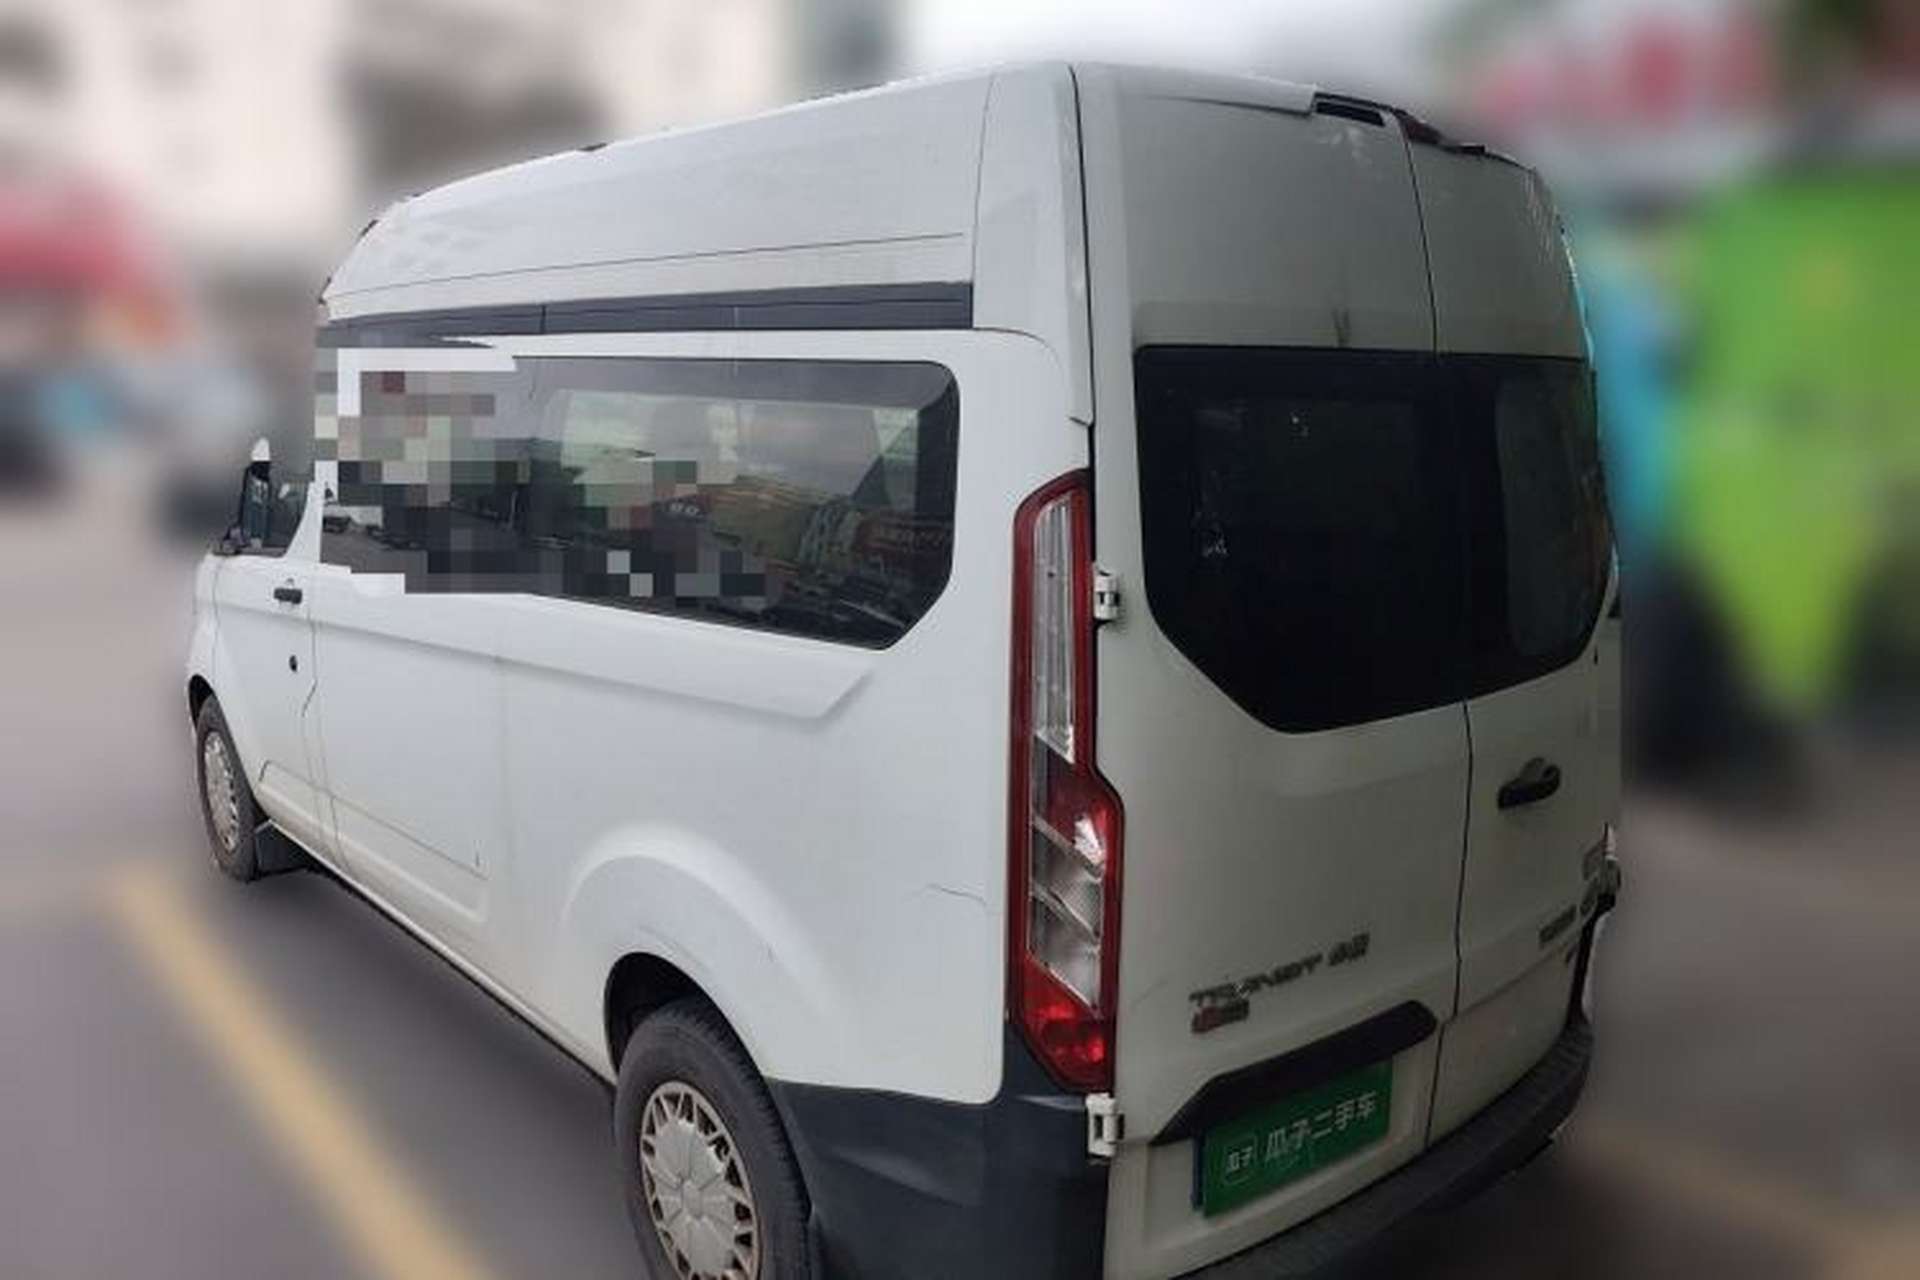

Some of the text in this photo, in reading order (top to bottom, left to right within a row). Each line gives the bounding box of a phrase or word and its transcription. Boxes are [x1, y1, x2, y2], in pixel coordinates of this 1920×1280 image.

[1265, 1090, 1377, 1163] 瓜子二手车
